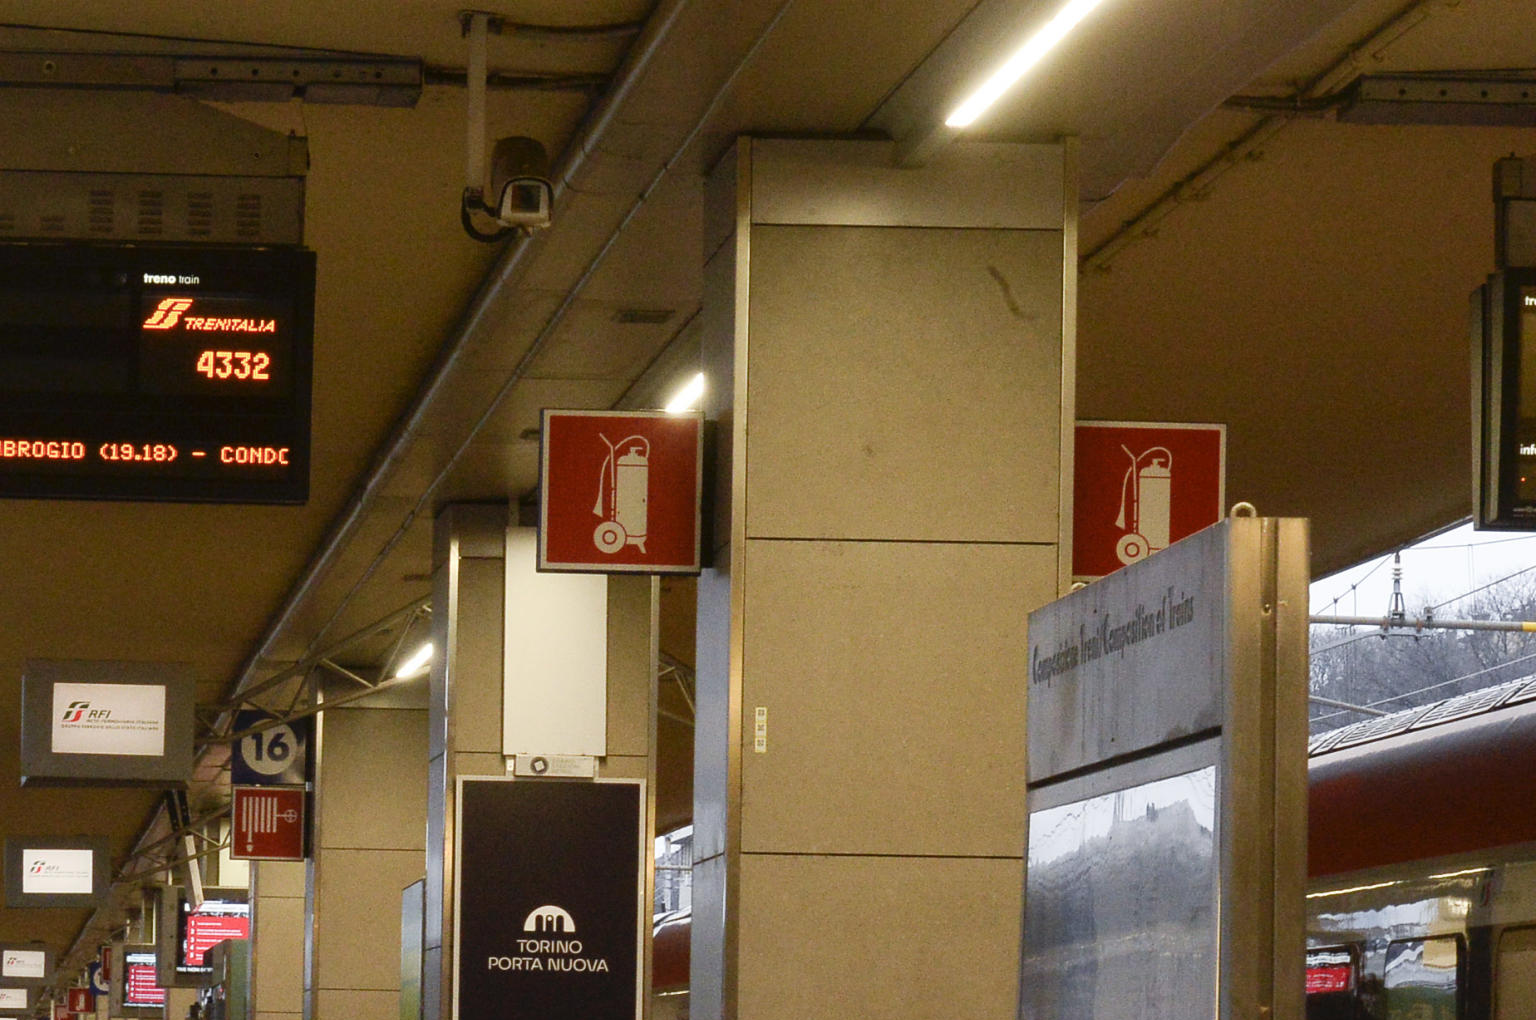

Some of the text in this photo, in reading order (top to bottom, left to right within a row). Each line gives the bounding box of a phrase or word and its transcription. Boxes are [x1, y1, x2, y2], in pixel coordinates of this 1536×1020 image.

[143, 273, 200, 285] treno train
[184, 317, 276, 333] TRENITALIA
[196, 351, 270, 380] 4332
[99, 443, 179, 462] (19.18)
[88, 709, 112, 719] RFI
[251, 732, 290, 762] 16
[516, 939, 583, 954] TORINO
[488, 957, 609, 972] PORTA NUOVA
